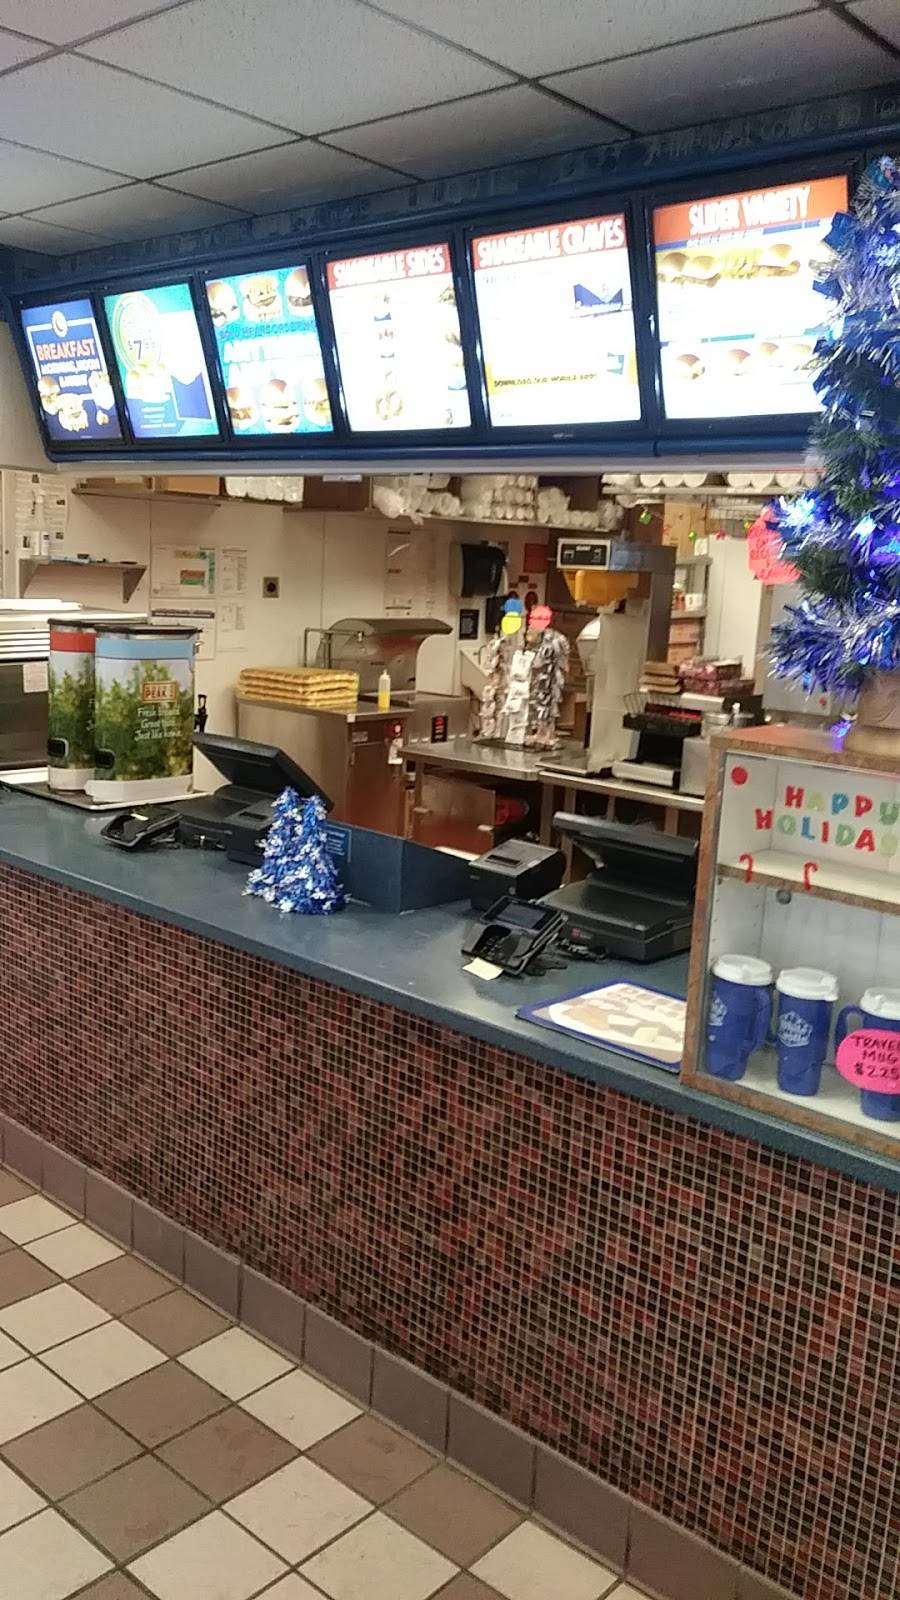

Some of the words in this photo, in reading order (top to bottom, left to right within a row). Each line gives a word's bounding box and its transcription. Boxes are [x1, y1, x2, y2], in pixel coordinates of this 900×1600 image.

[740, 184, 811, 226] VARIETY
[405, 245, 446, 277] SIDES
[477, 228, 560, 268] SHAREABLE
[561, 217, 625, 256] CRAVES
[36, 337, 95, 361] BREAKFAST
[784, 784, 900, 826] HAPPY
[862, 1050, 899, 1065] MUG
